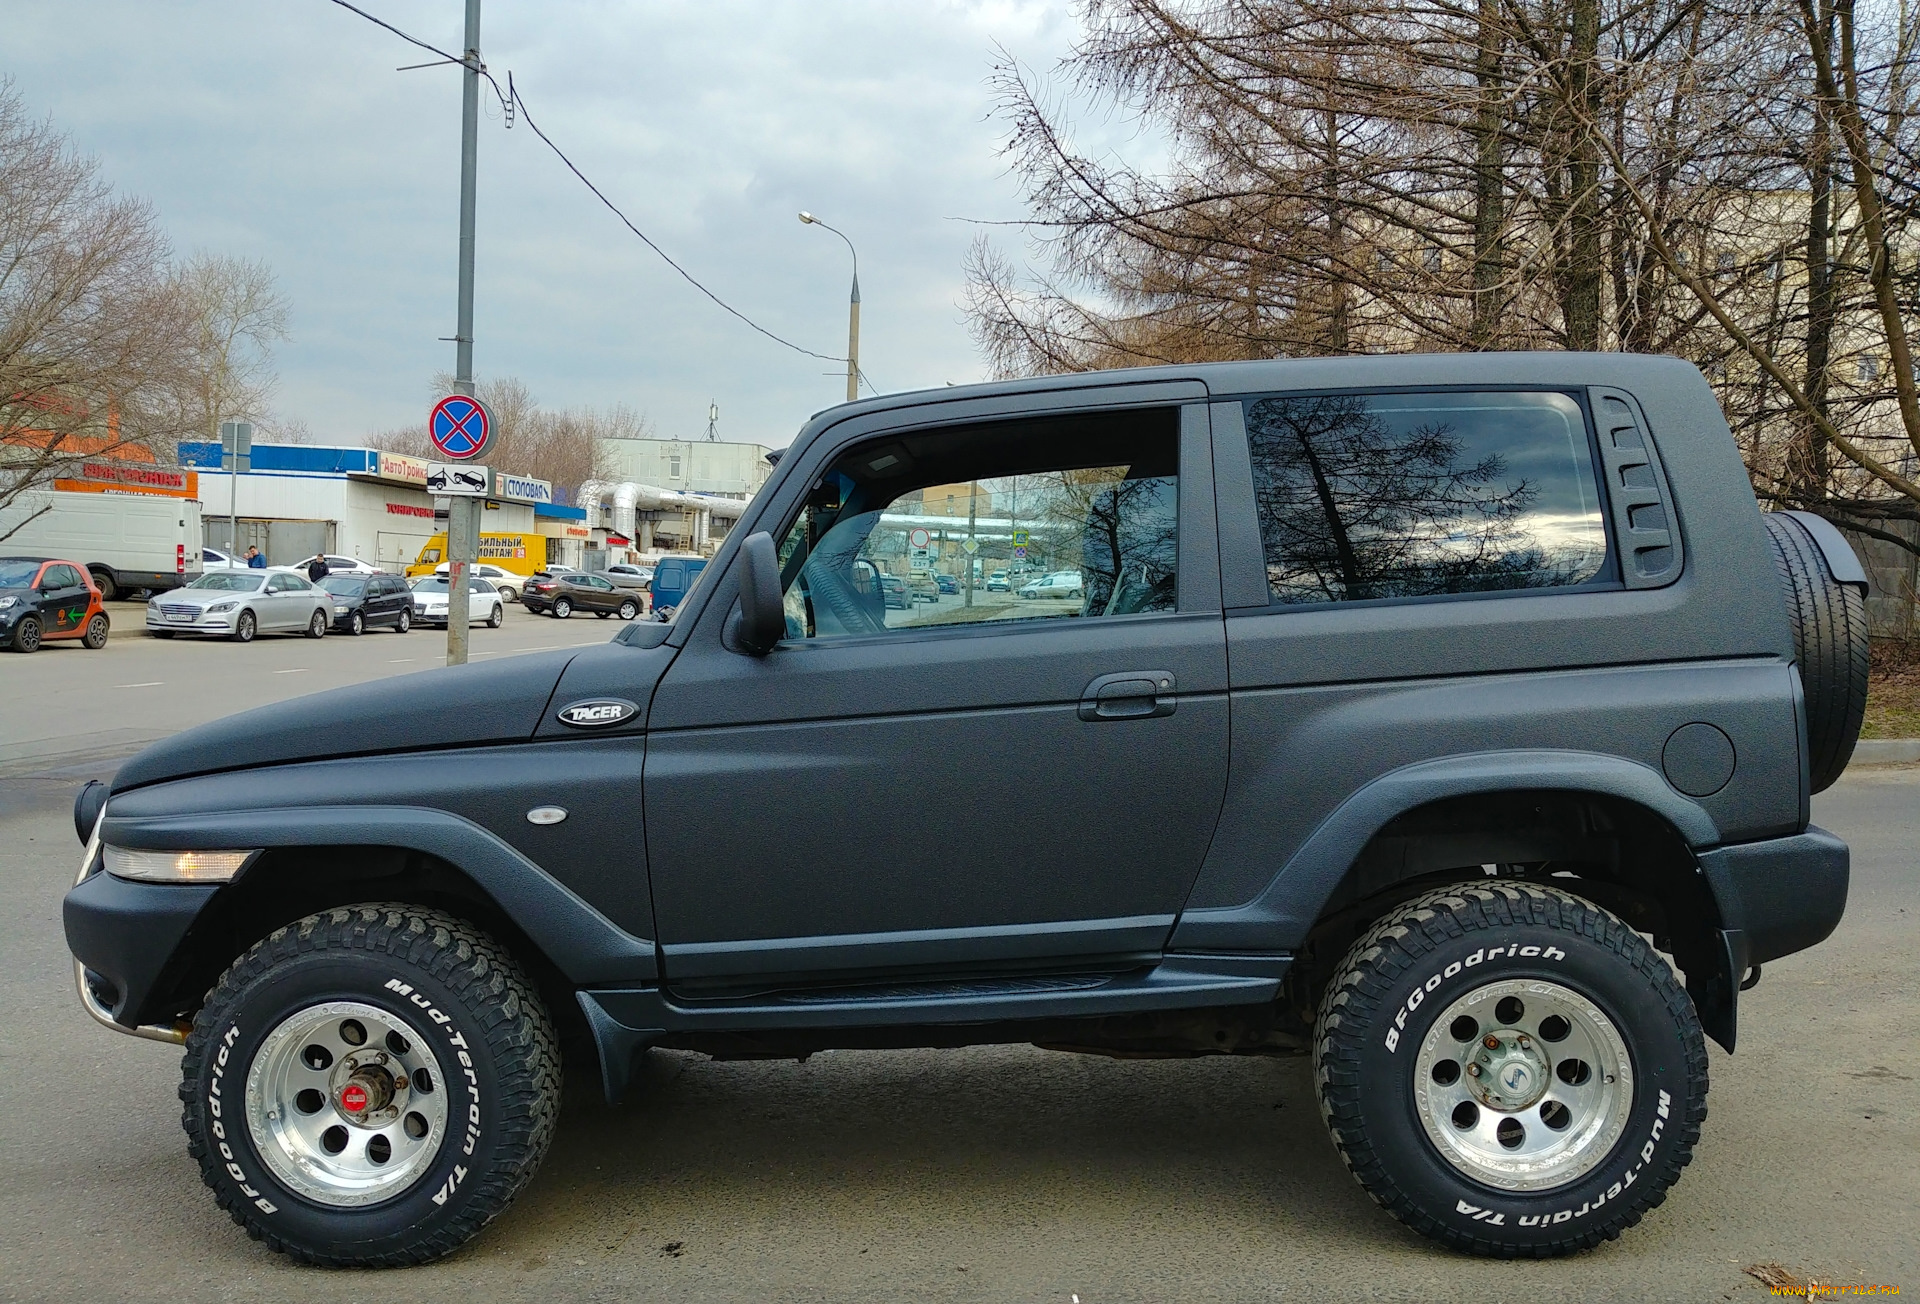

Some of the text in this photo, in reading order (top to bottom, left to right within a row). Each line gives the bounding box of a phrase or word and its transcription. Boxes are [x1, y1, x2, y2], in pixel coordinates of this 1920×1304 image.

[479, 536, 522, 547] БИЛЬНЫЙ
[570, 705, 622, 721] TAGER
[1384, 943, 1566, 1054] BFGoodrich
[208, 1026, 279, 1215] BFGoodrich
[384, 978, 481, 1207] Mud-Terrain T/A
[1455, 1090, 1671, 1229] Mud-Terrain T/A
